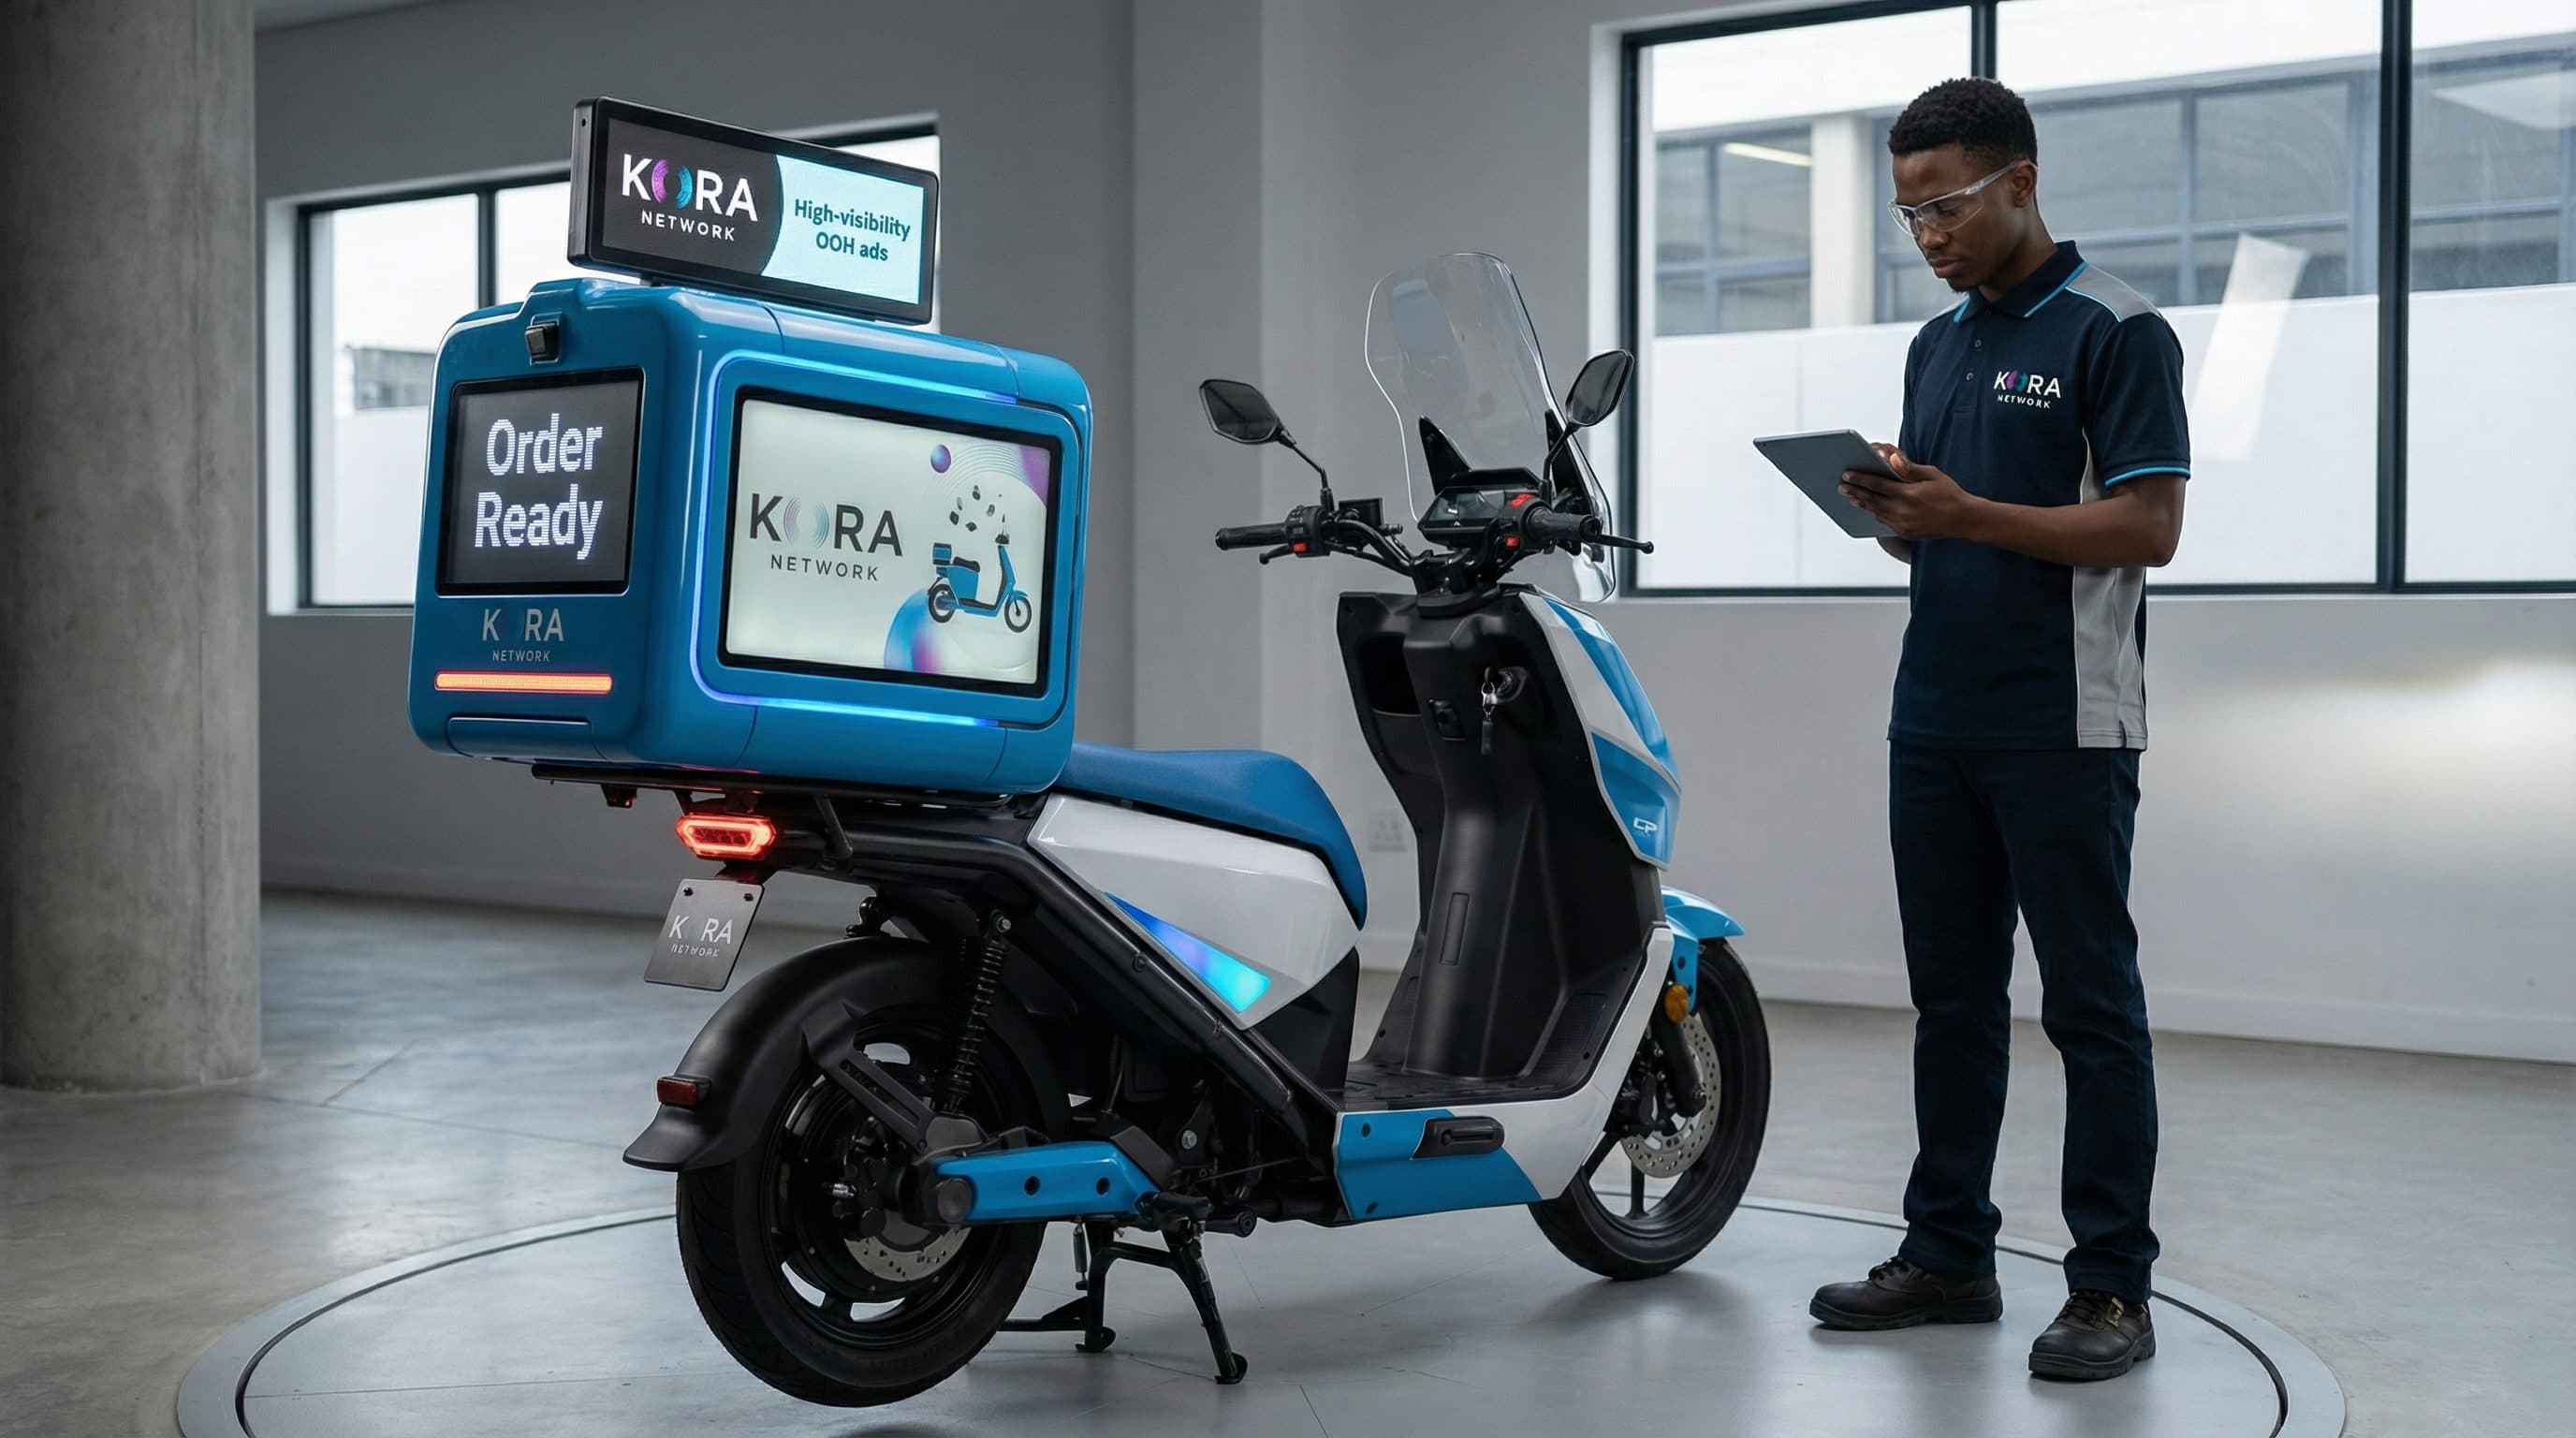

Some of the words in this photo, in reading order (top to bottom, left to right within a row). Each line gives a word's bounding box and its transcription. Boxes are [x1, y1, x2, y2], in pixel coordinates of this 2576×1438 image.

[641, 209, 736, 242] NETWORK
[795, 198, 912, 242] High-visibility
[815, 231, 856, 256] OOH
[859, 241, 889, 262] ads
[1997, 394, 2052, 410] NETWORK
[486, 413, 604, 477] Order
[474, 483, 604, 561] Ready
[770, 553, 879, 582] NETWORK
[482, 608, 565, 642] KRA
[491, 650, 550, 663] NETWORK
[668, 915, 733, 946] KRA
